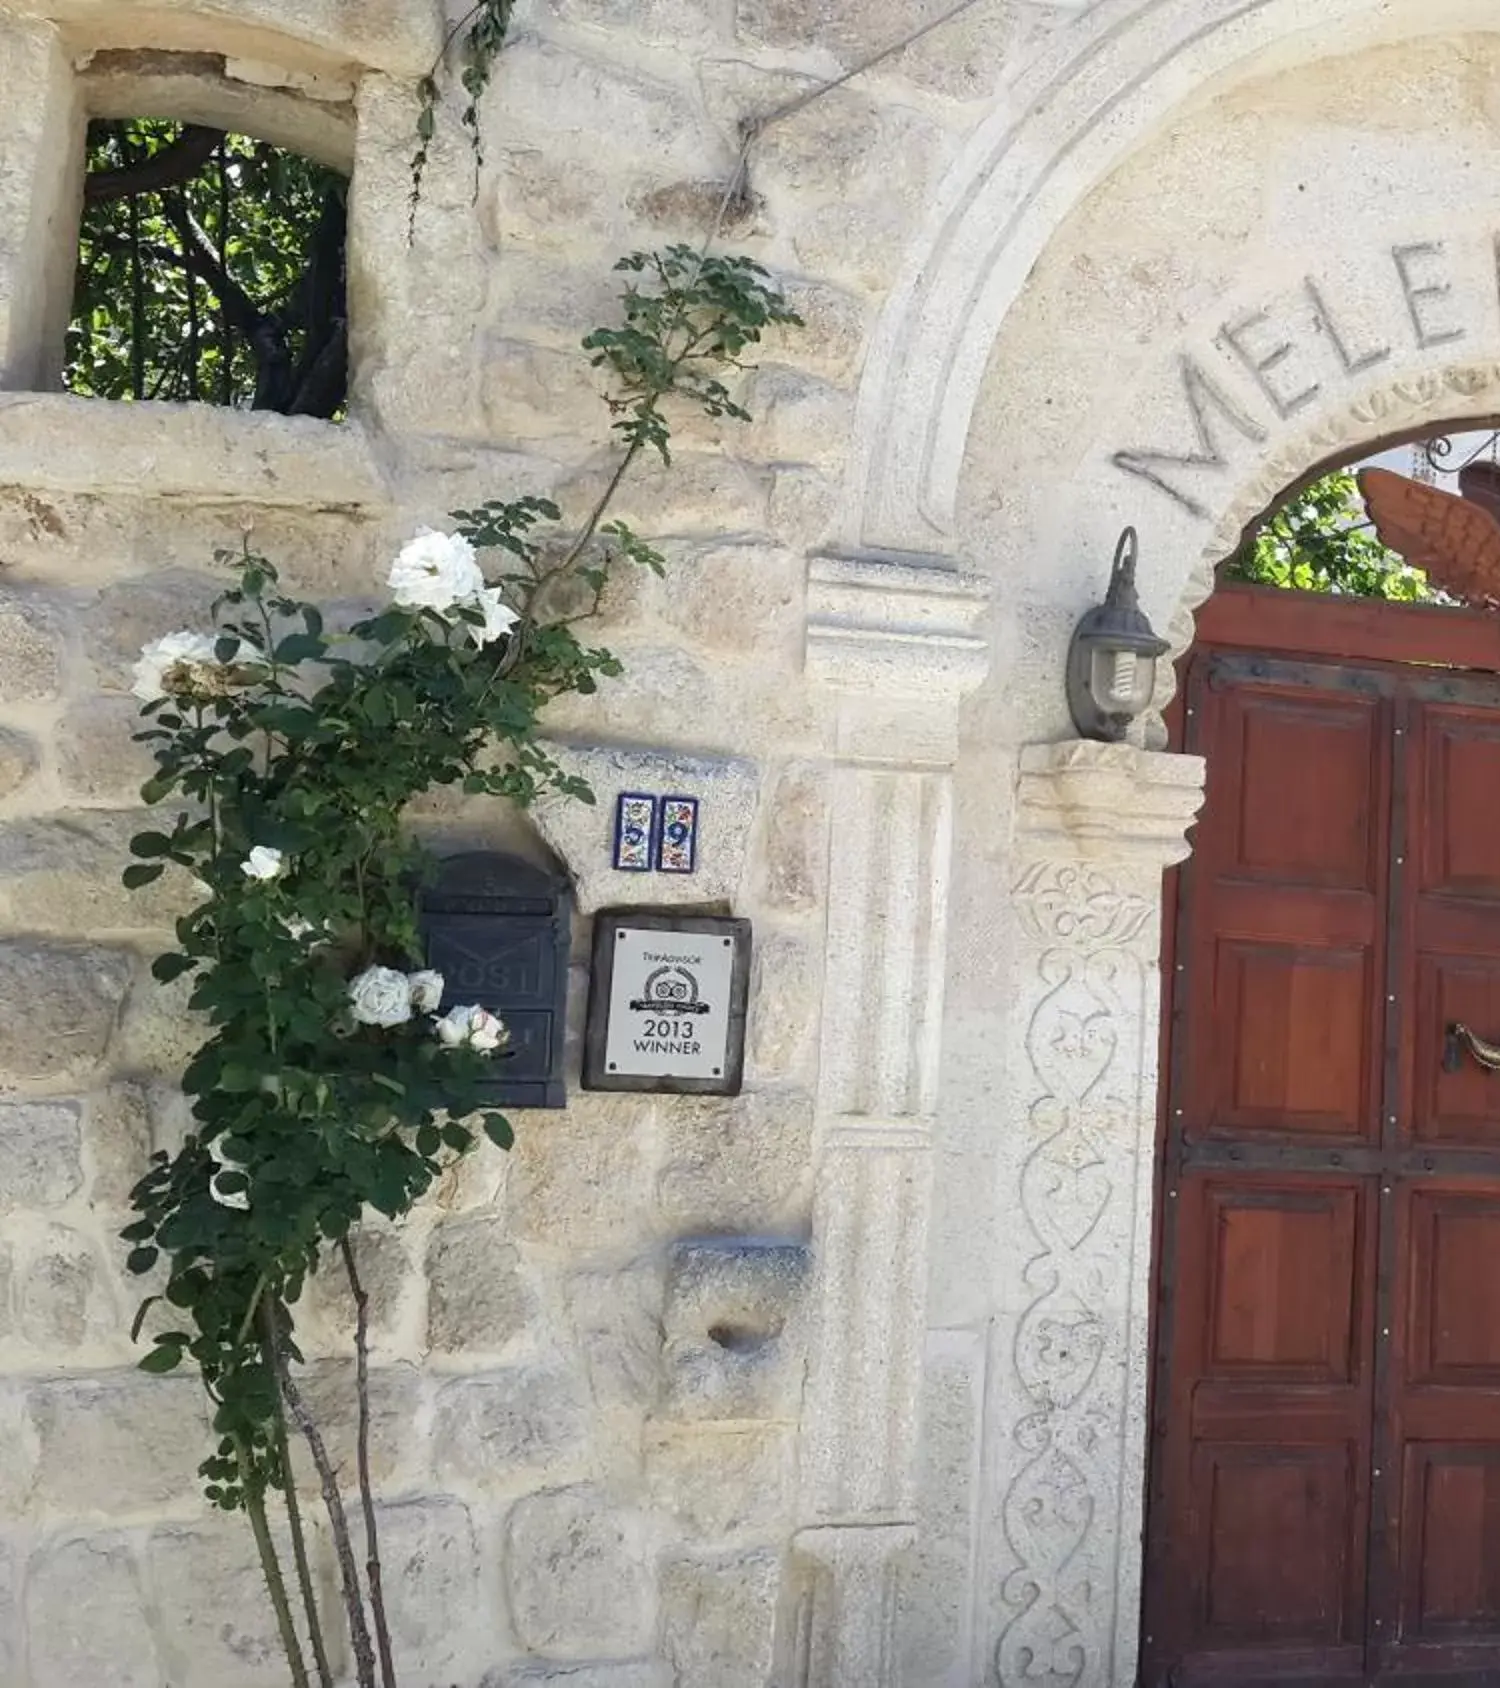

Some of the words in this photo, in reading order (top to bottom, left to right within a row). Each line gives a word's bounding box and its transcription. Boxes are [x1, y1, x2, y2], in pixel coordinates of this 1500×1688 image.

[623, 821, 690, 848] 59
[643, 1019, 694, 1039] 2013
[633, 1040, 702, 1055] WINNER
